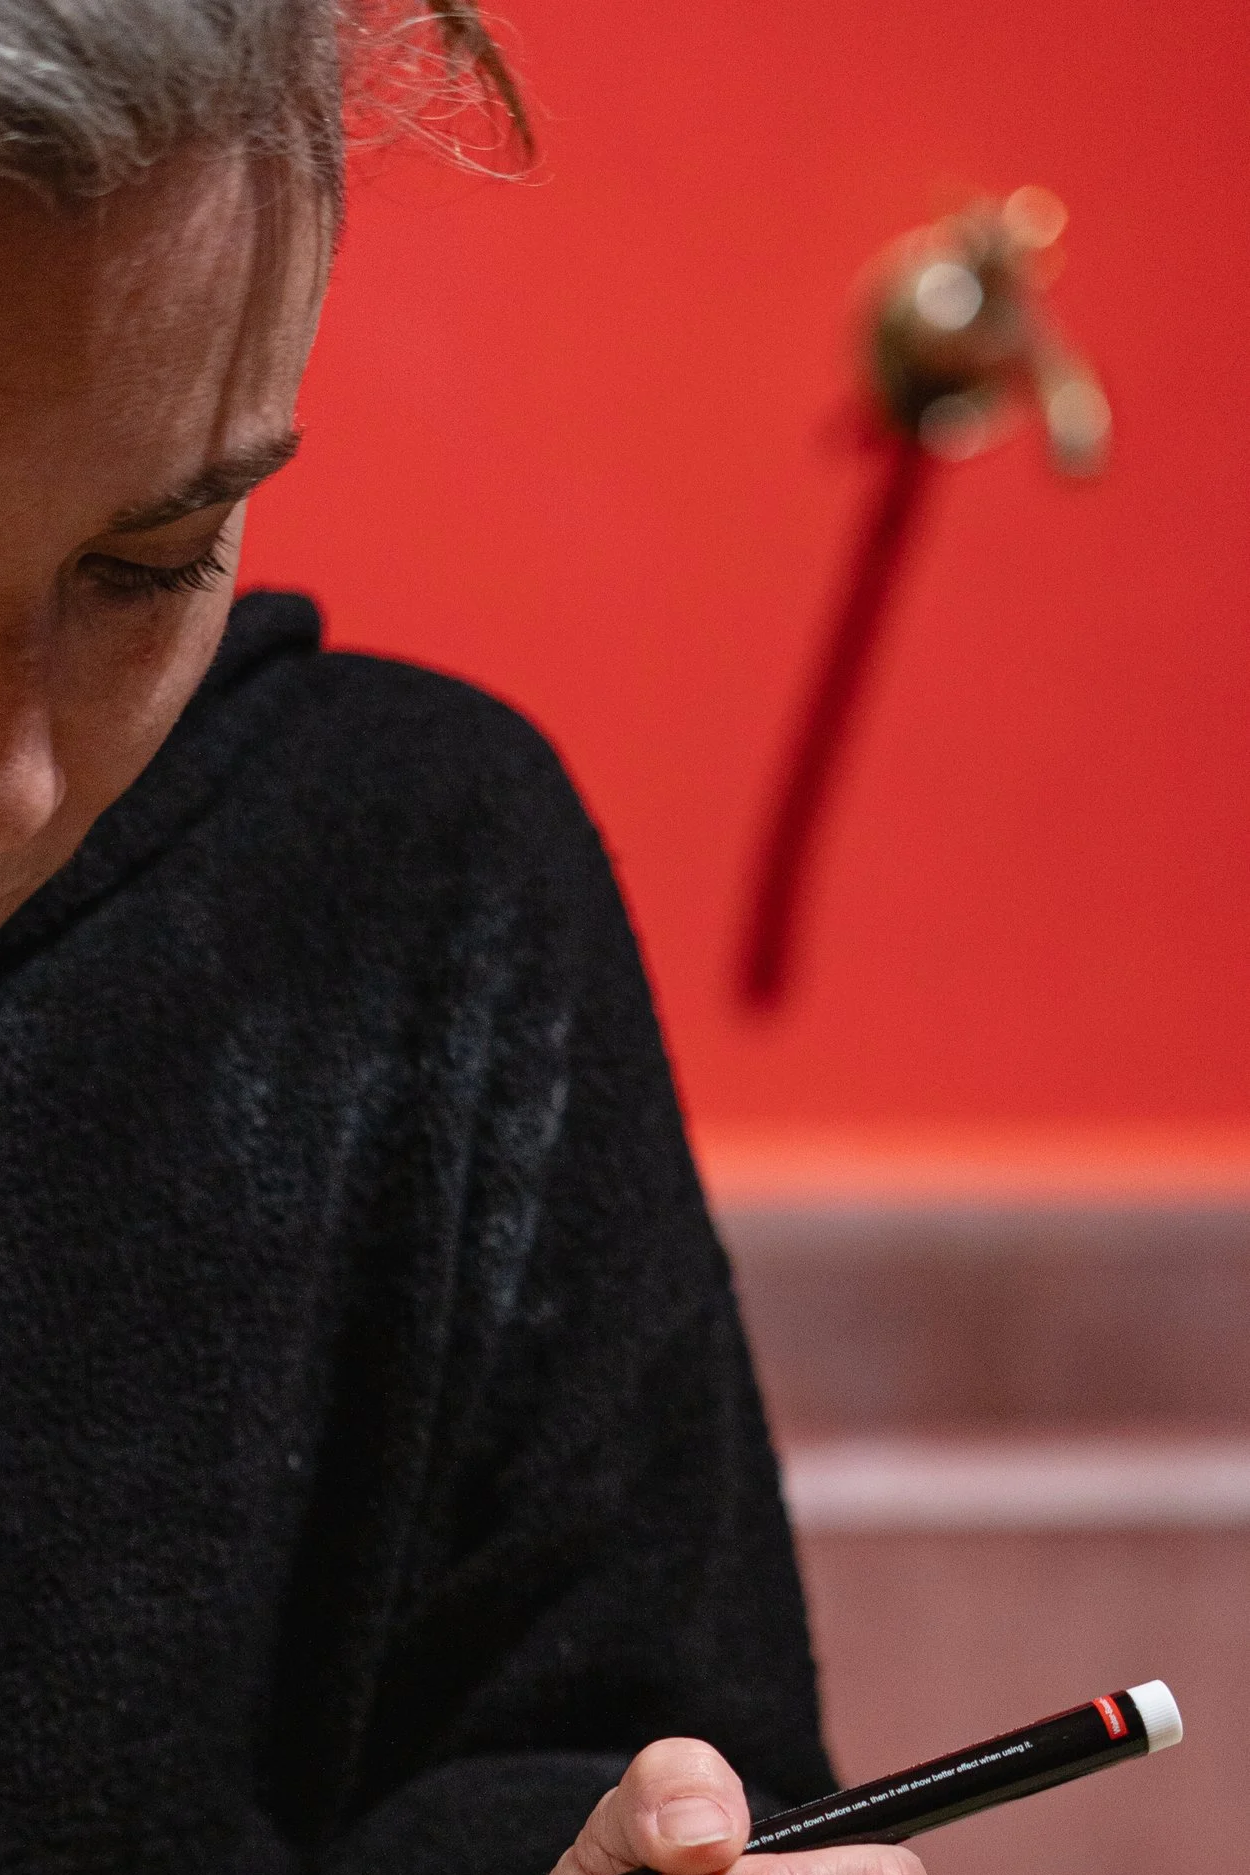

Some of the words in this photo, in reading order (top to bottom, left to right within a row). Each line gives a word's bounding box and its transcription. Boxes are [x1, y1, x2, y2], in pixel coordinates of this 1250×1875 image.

[744, 1838, 760, 1850] ace
[760, 1834, 774, 1845] the
[775, 1828, 791, 1841] pen
[791, 1823, 802, 1833] tip
[803, 1815, 825, 1829] down
[825, 1807, 852, 1821] before
[852, 1800, 870, 1811] use,
[870, 1792, 889, 1804] then
[888, 1789, 896, 1797] it
[896, 1784, 909, 1795] will
[910, 1778, 931, 1790] show
[931, 1768, 956, 1782] better
[956, 1759, 980, 1773] effect
[979, 1752, 1001, 1765] when
[1001, 1744, 1025, 1758] using
[1024, 1741, 1033, 1750] it.
